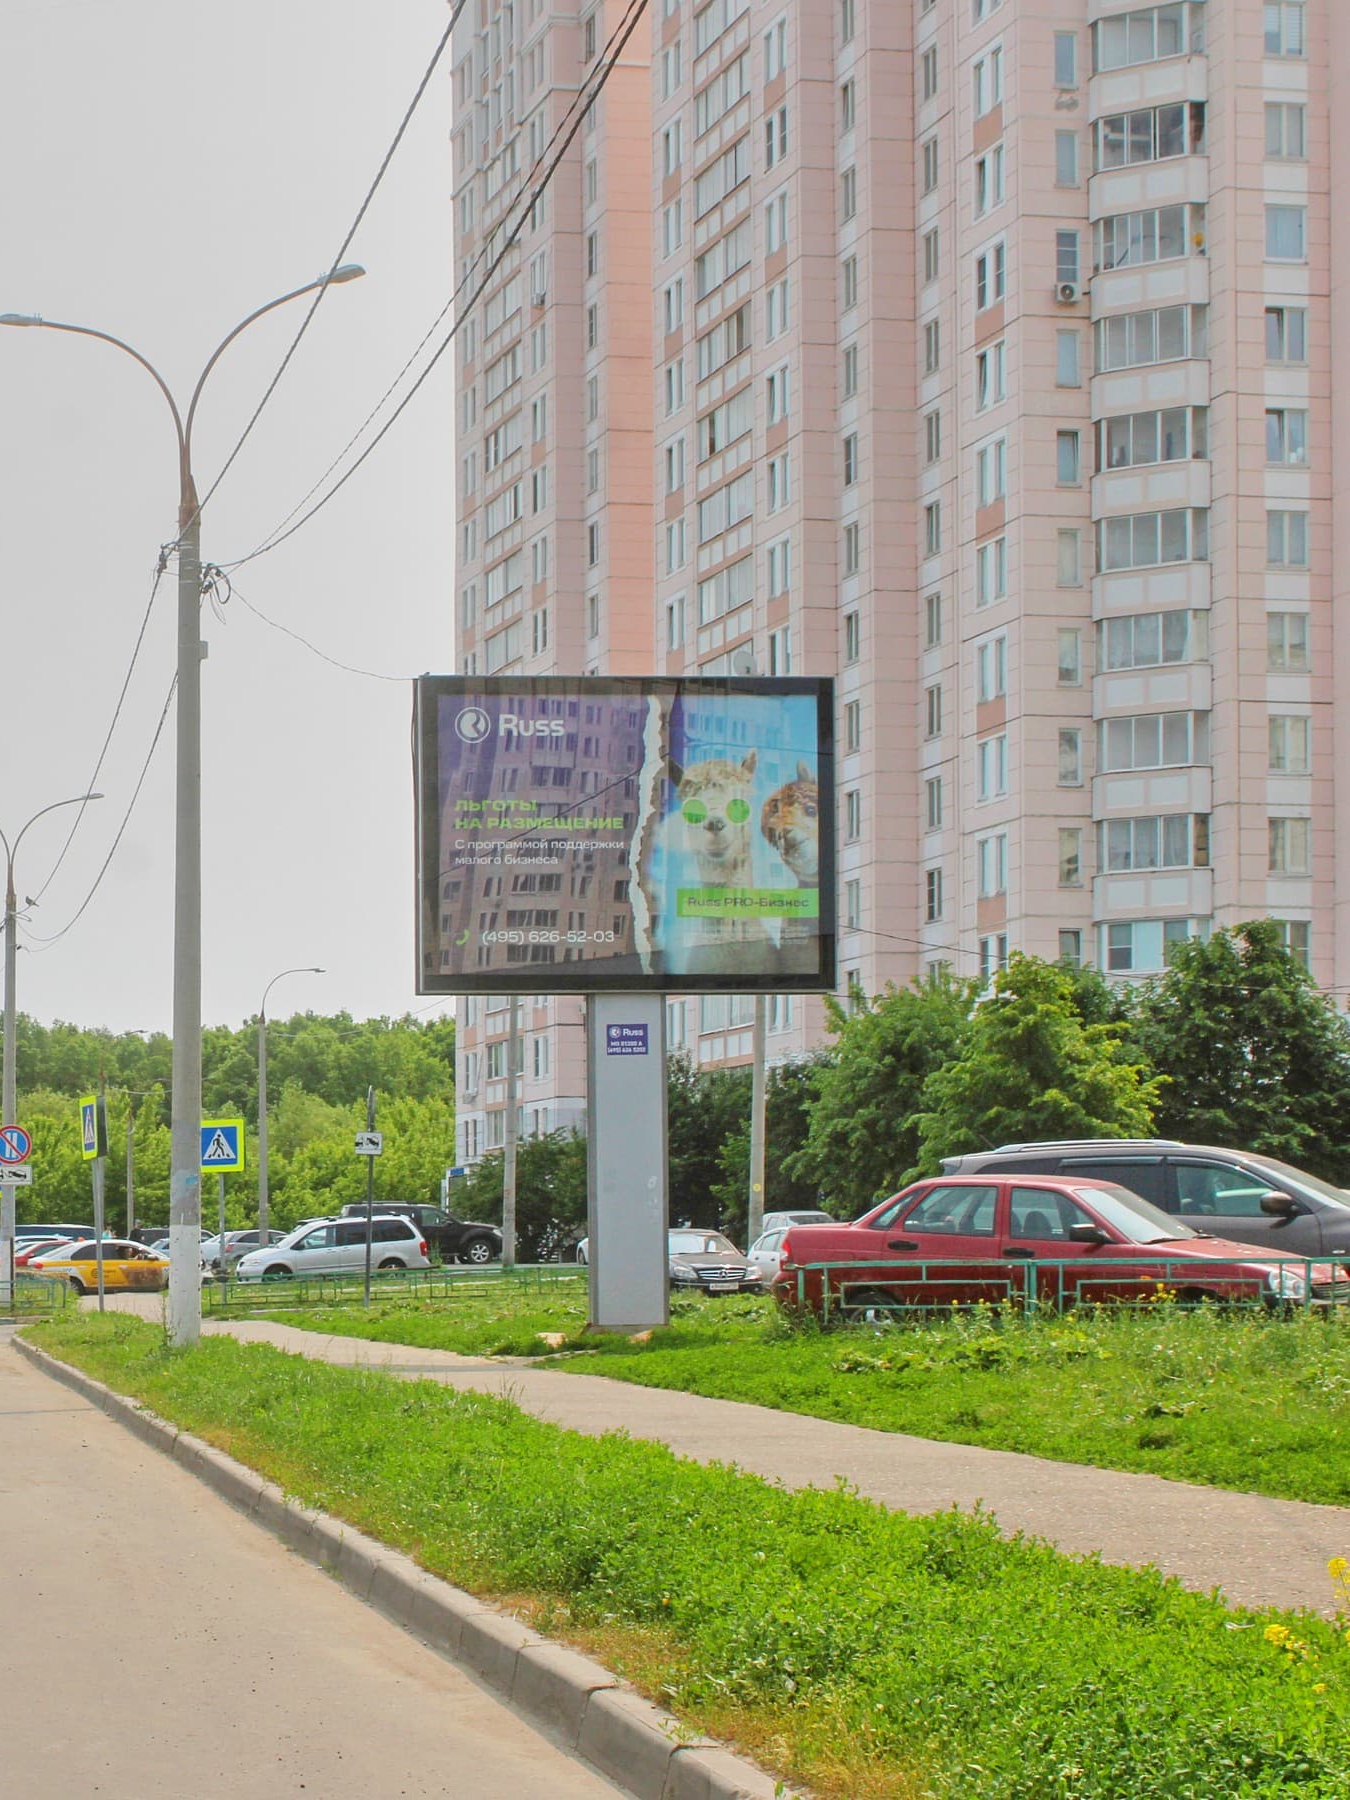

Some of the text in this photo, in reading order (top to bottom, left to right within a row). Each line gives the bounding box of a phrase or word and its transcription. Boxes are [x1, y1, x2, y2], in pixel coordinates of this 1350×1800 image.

[499, 713, 565, 737] Russ
[454, 800, 537, 812] ЛЬГОТЫ
[454, 818, 624, 832] НА РАЗМЕЩЕНИЕ
[454, 838, 625, 851] С программой поддержки
[455, 854, 559, 865] малого бизнеса
[688, 896, 810, 908] Russ PRO-Бизнес
[482, 930, 615, 945] (495) 626-52-03
[622, 1028, 644, 1037] Russ
